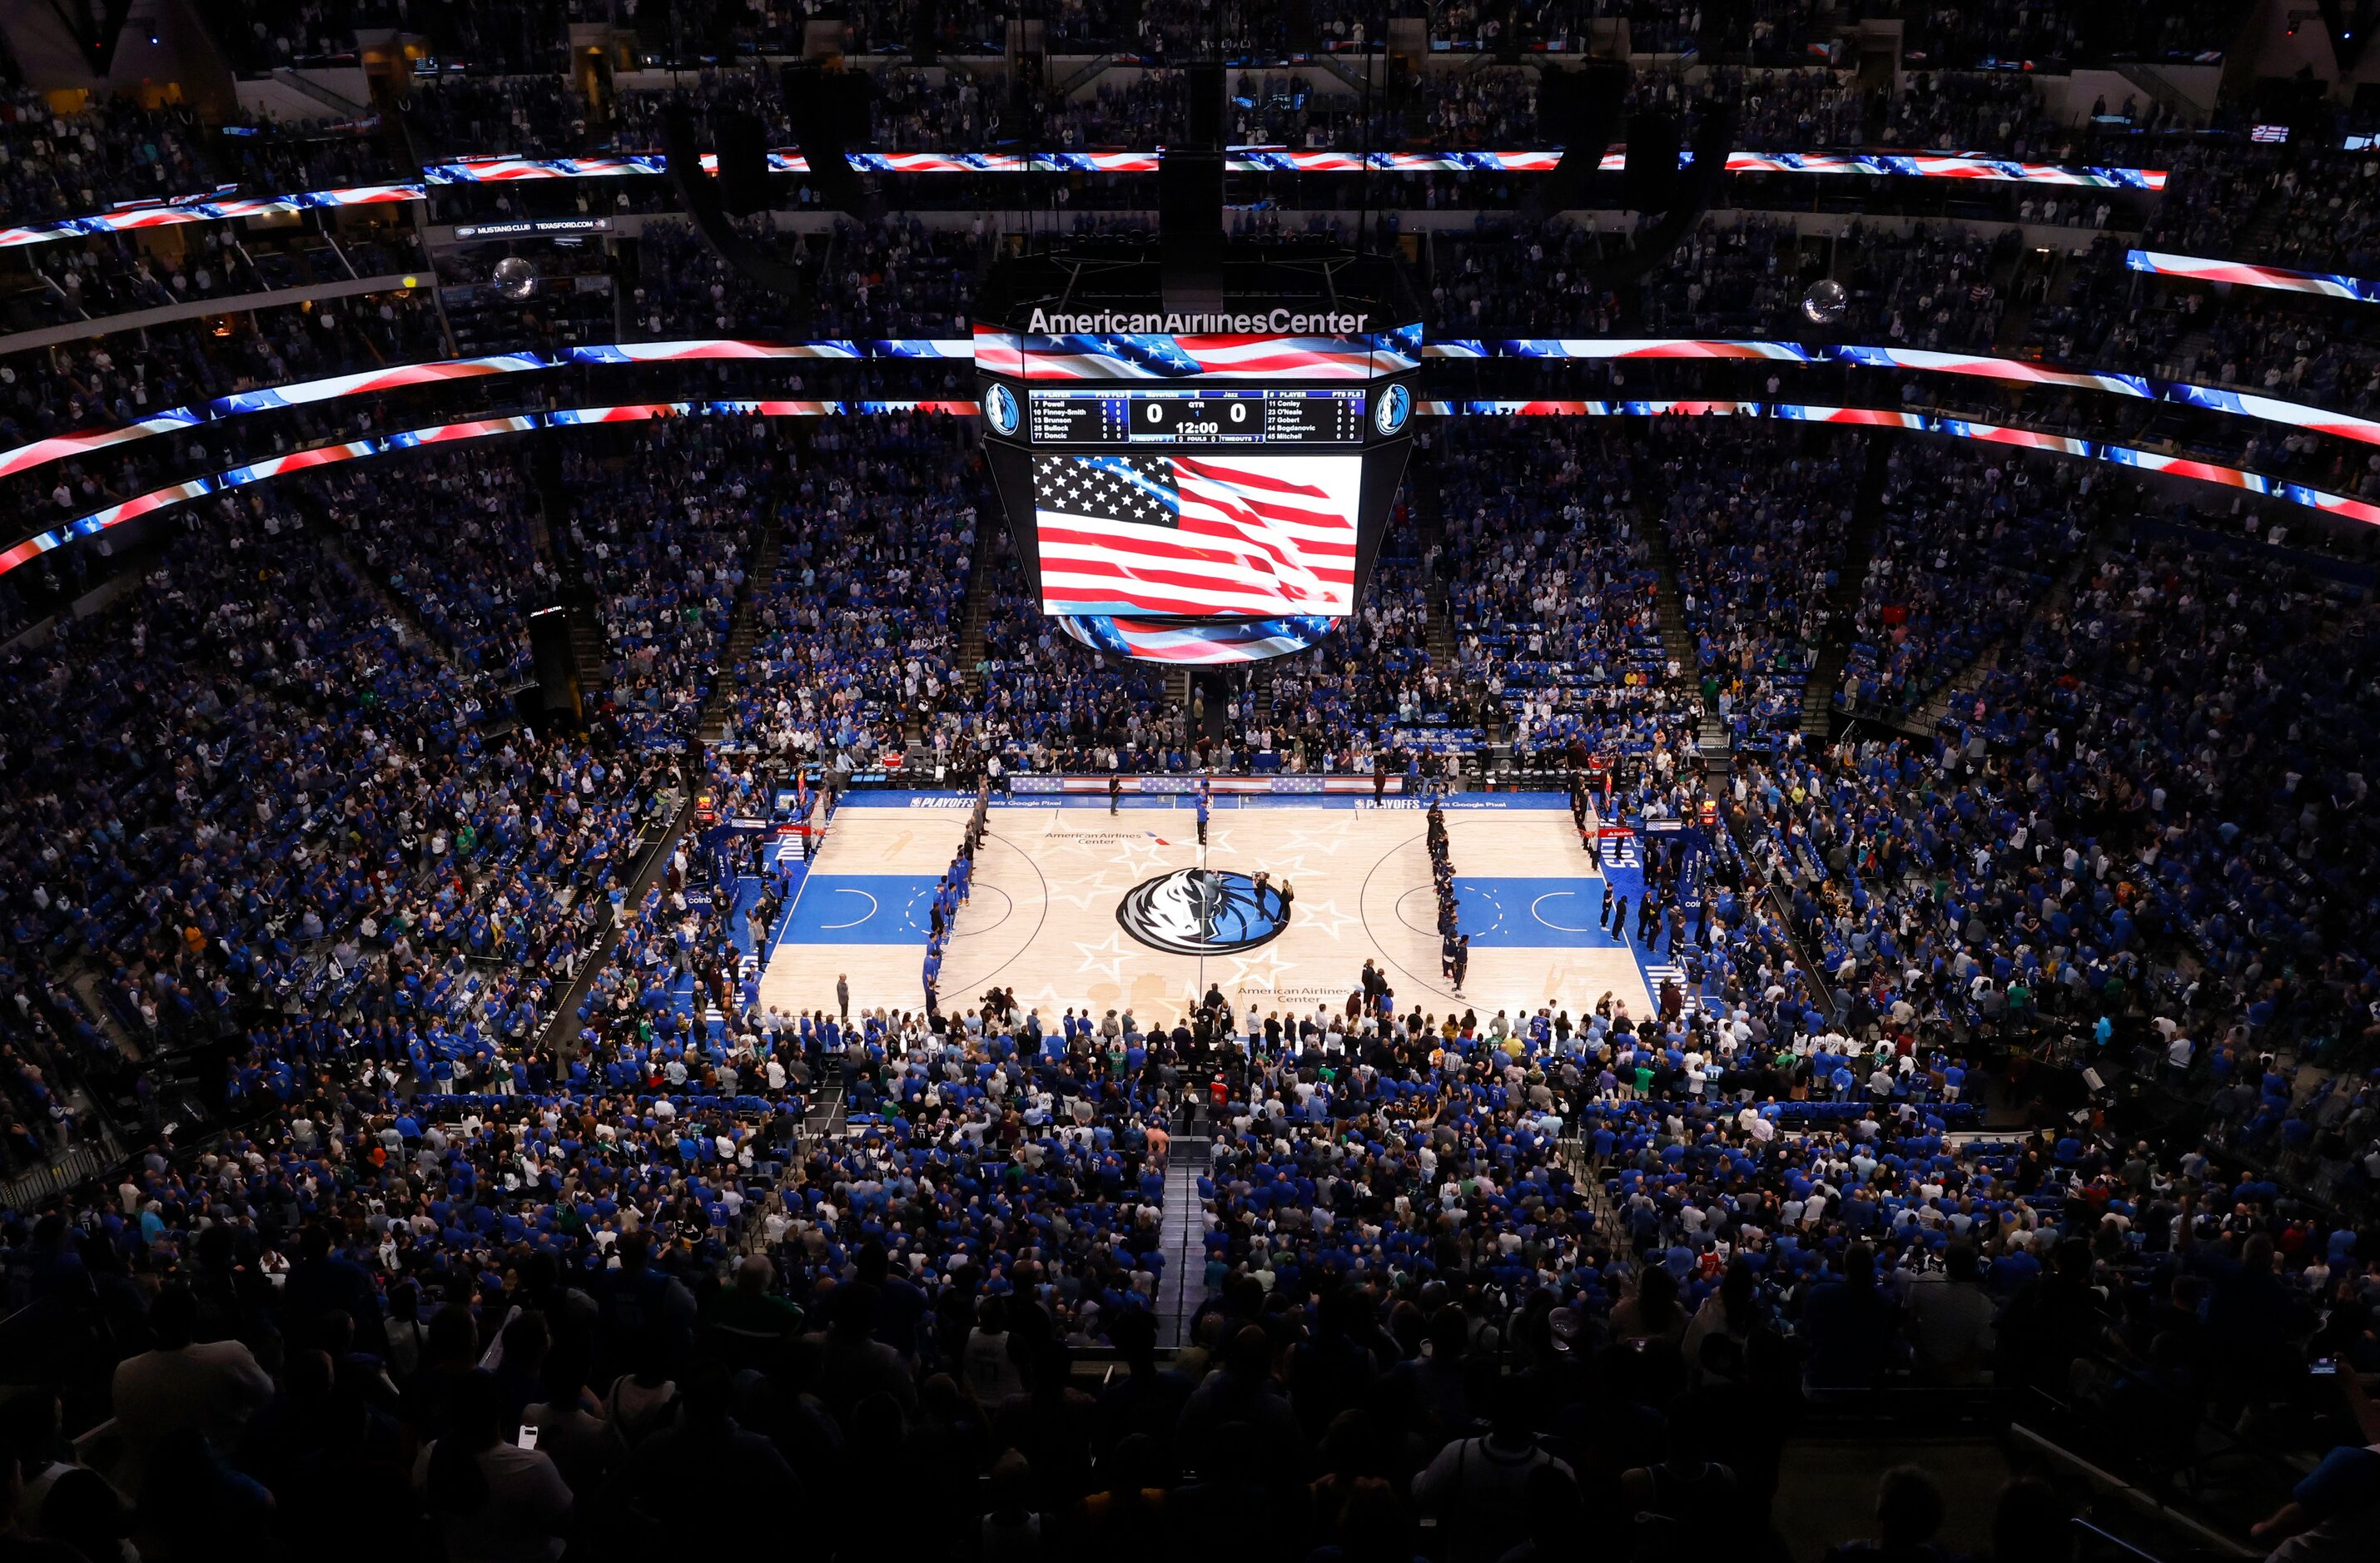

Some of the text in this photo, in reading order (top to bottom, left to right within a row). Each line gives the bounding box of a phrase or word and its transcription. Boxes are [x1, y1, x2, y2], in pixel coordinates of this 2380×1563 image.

[477, 226, 512, 234] MUSTANG
[535, 221, 594, 230] TEXASFORD.COM
[1146, 404, 1163, 424] 0
[1230, 403, 1247, 423] 0
[1175, 422, 1219, 434] 12:00
[920, 797, 977, 808] PLAYOFFS
